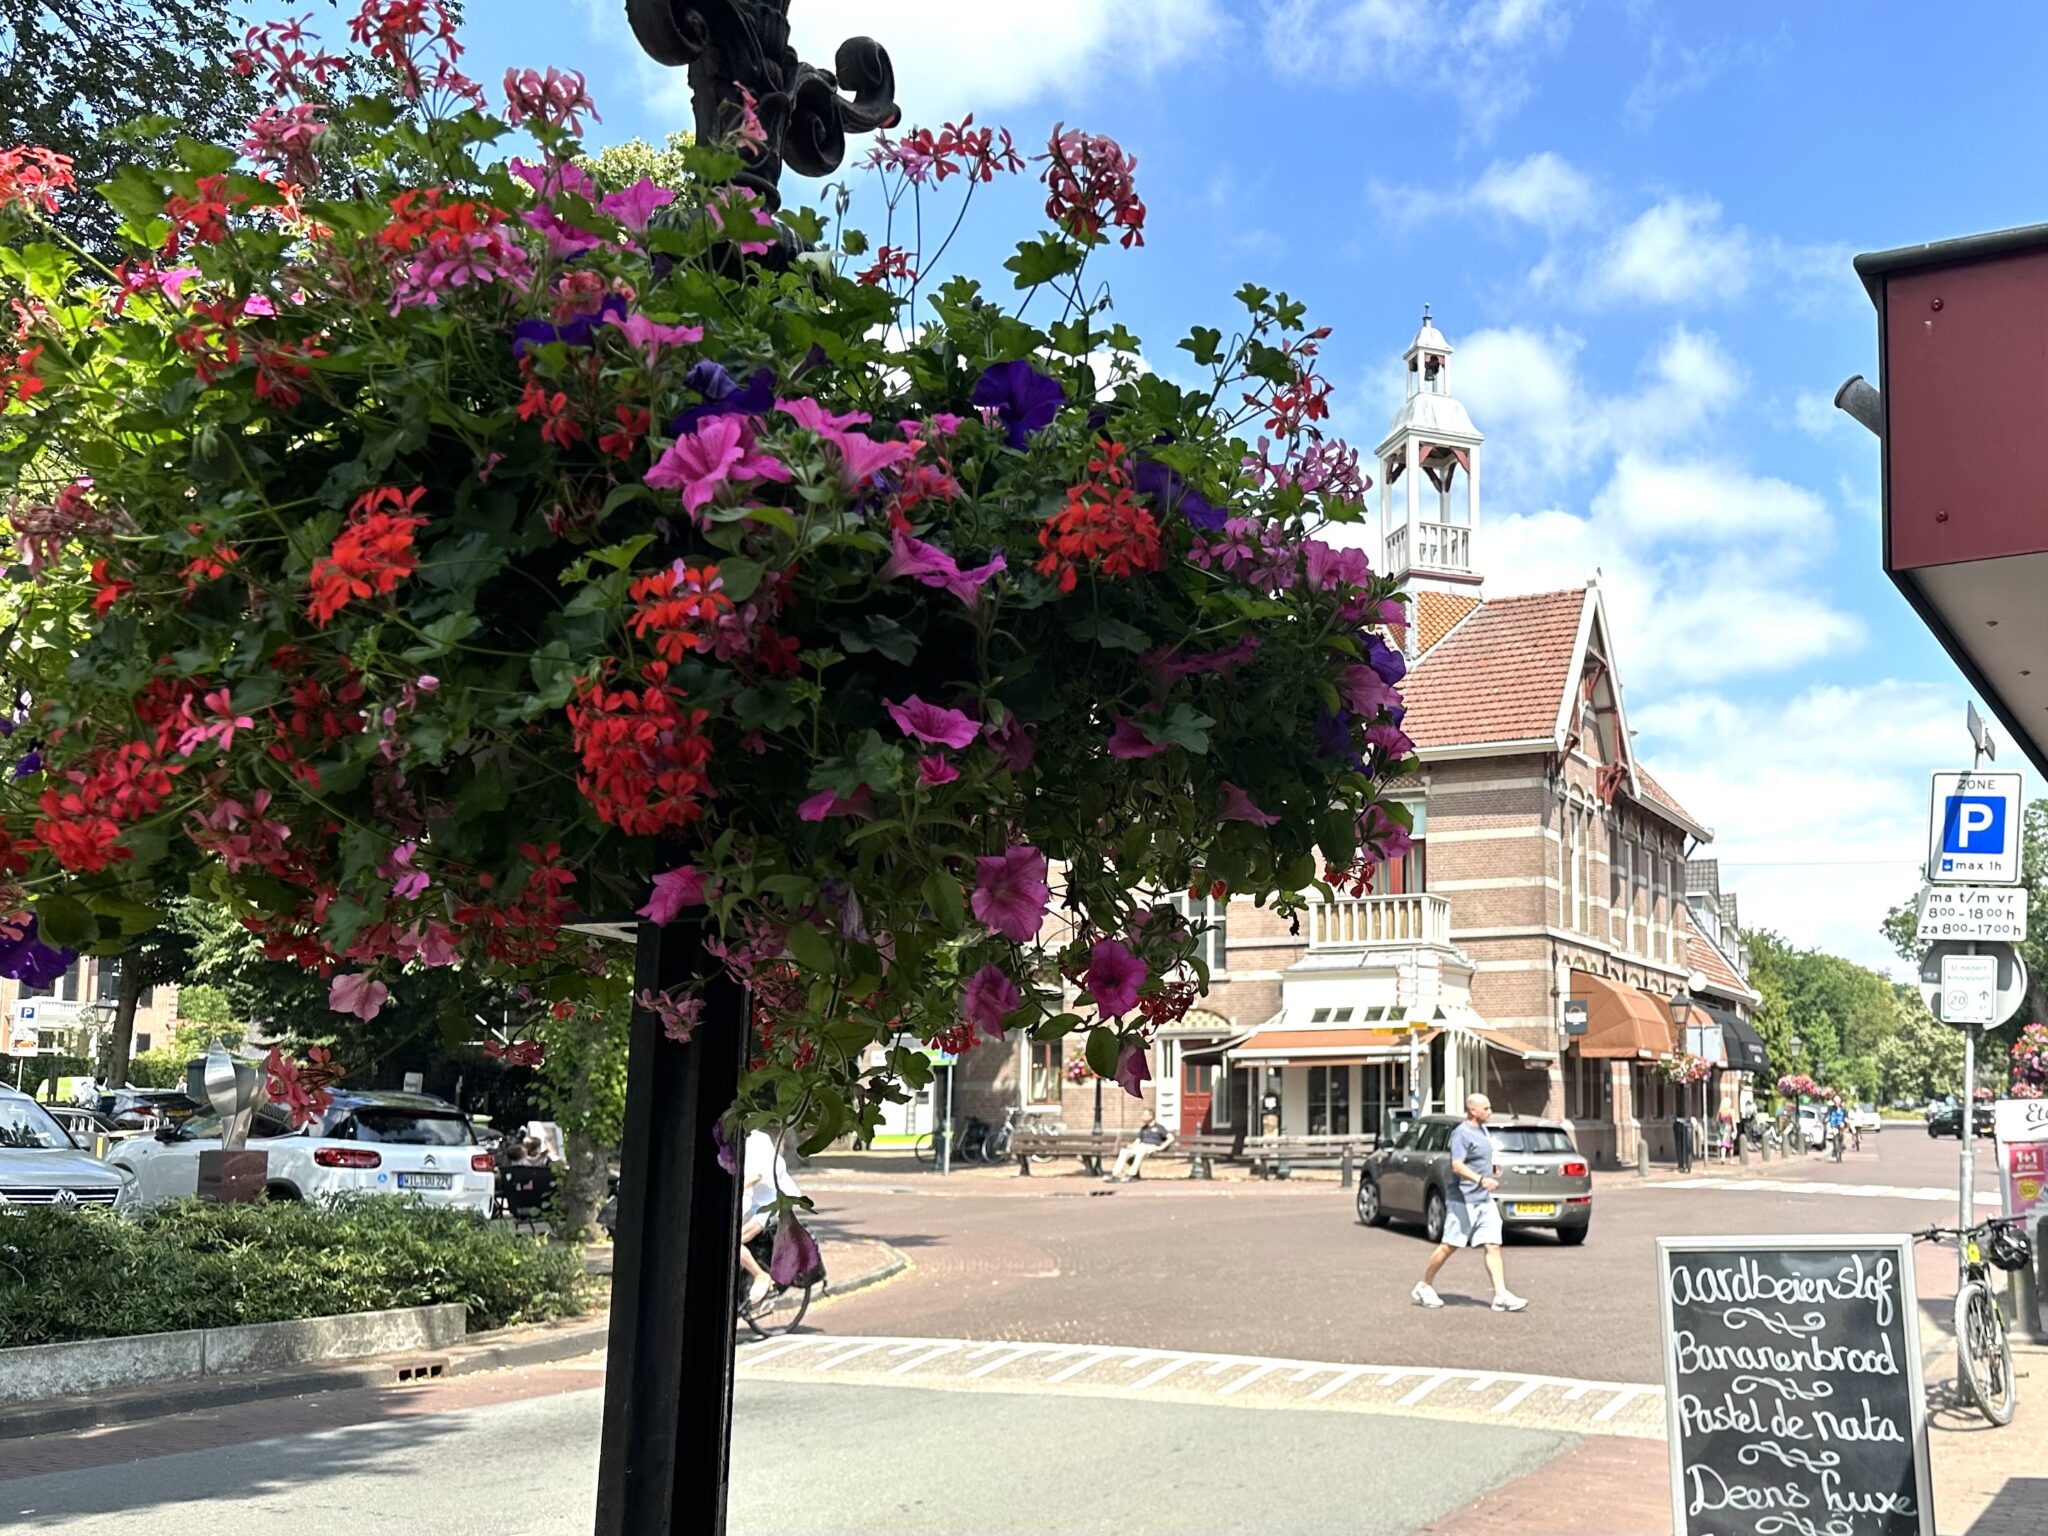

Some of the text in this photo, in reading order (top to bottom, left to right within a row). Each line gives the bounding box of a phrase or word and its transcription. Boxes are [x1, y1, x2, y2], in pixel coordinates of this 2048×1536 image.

[1957, 779, 1996, 790] ZONE
[1958, 803, 1994, 848] P
[1956, 860, 2002, 871] max 1h
[1929, 891, 2014, 904] ma t/m vr
[1921, 925, 1938, 934] za
[1950, 995, 1967, 1006] 20
[2016, 1150, 2038, 1164] 1+1
[1674, 1331, 1899, 1376] Bananenbrood
[1679, 1394, 1767, 1438] Pastel
[1771, 1396, 1813, 1440] de
[1686, 1463, 1811, 1517] Deens
